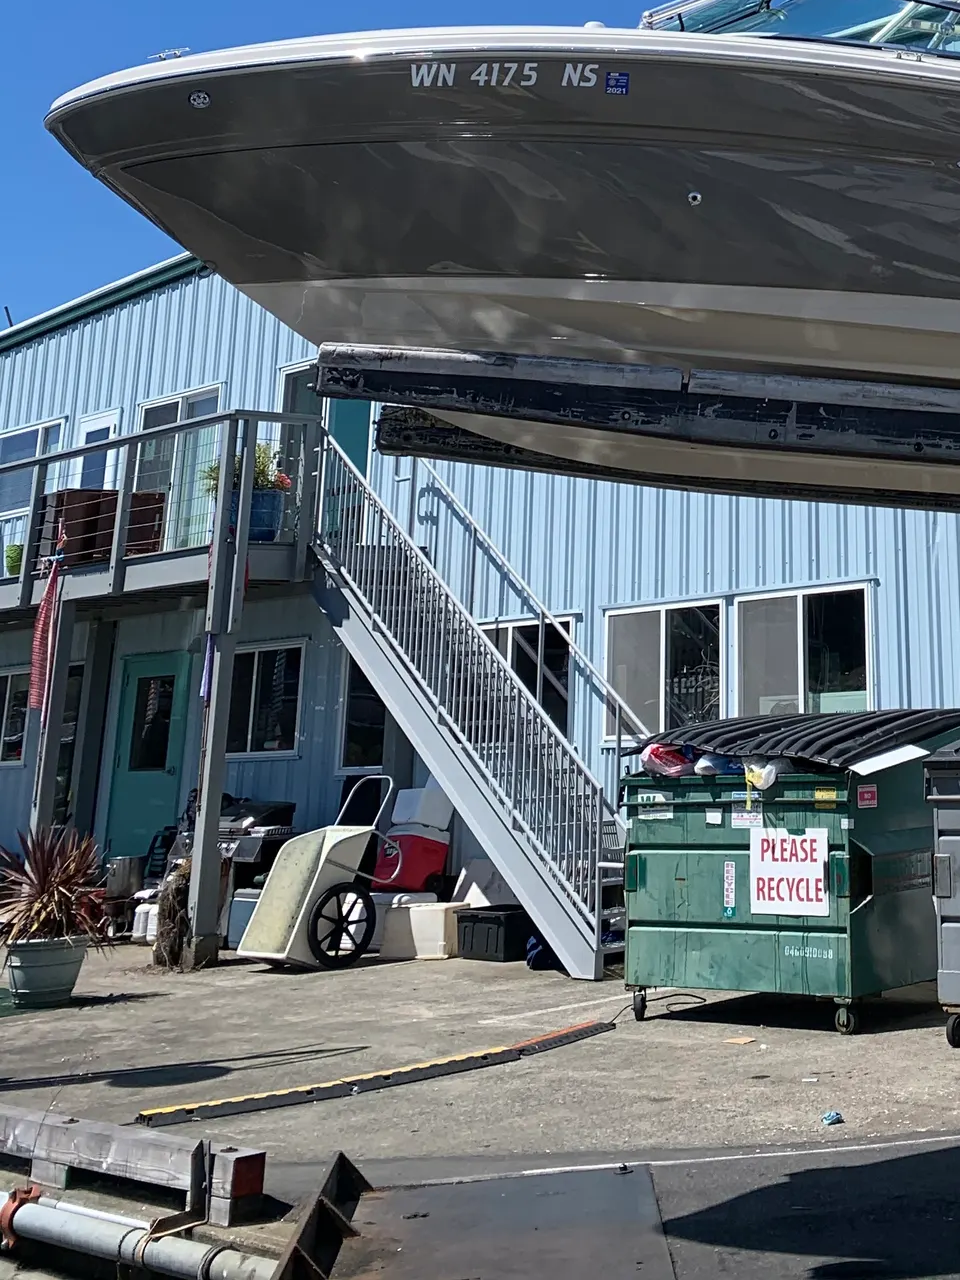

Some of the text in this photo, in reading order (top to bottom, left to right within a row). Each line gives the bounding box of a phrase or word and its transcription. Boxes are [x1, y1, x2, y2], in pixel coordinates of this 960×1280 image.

[410, 63, 599, 87] WN 4175 NS
[760, 838, 818, 862] PLEASE
[725, 862, 735, 906] RECYCLE
[756, 877, 823, 903] RECYCLE
